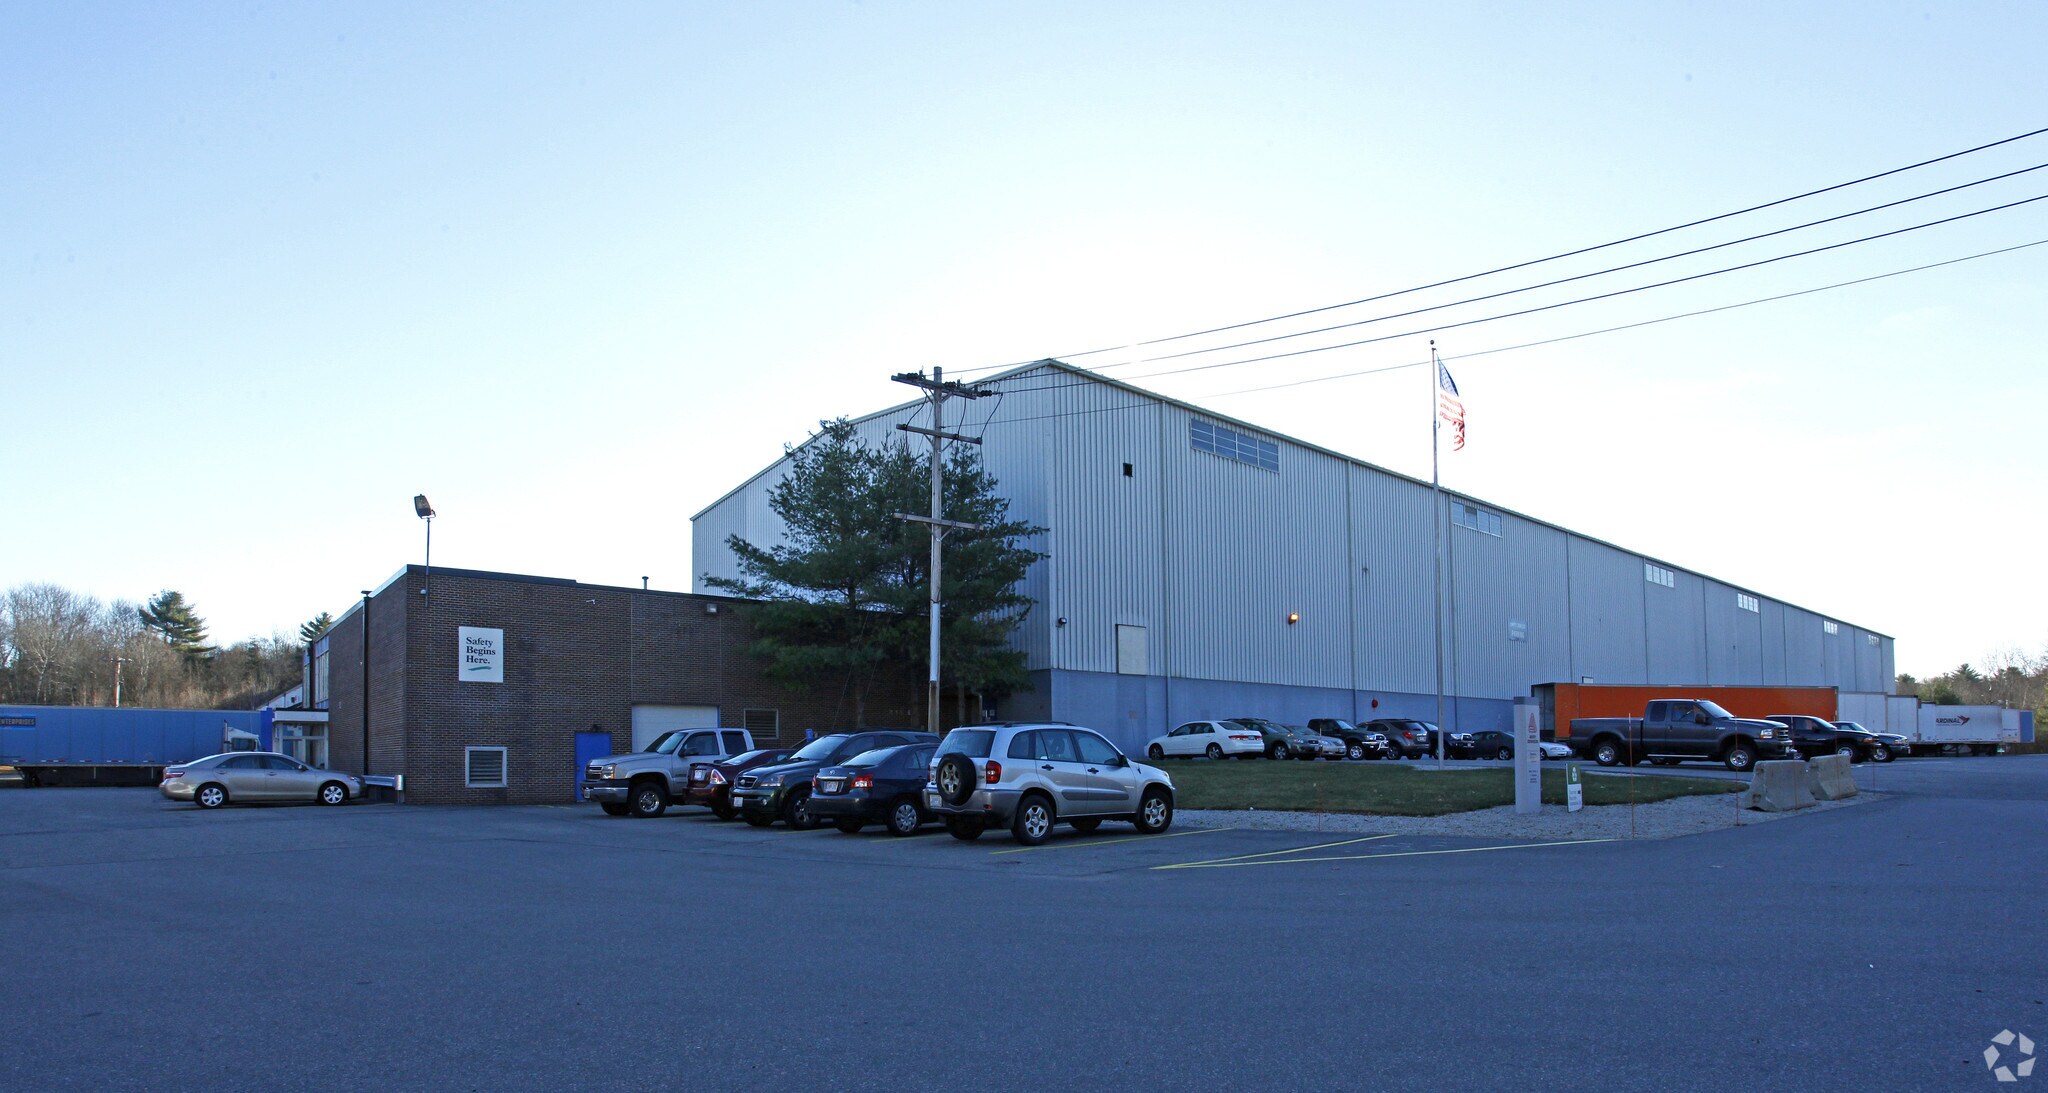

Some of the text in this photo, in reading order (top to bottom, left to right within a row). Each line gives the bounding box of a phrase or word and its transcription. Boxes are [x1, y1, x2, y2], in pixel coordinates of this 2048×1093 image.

[466, 636, 493, 648] Safety
[466, 646, 496, 656] Begins
[466, 655, 490, 664] Here.
